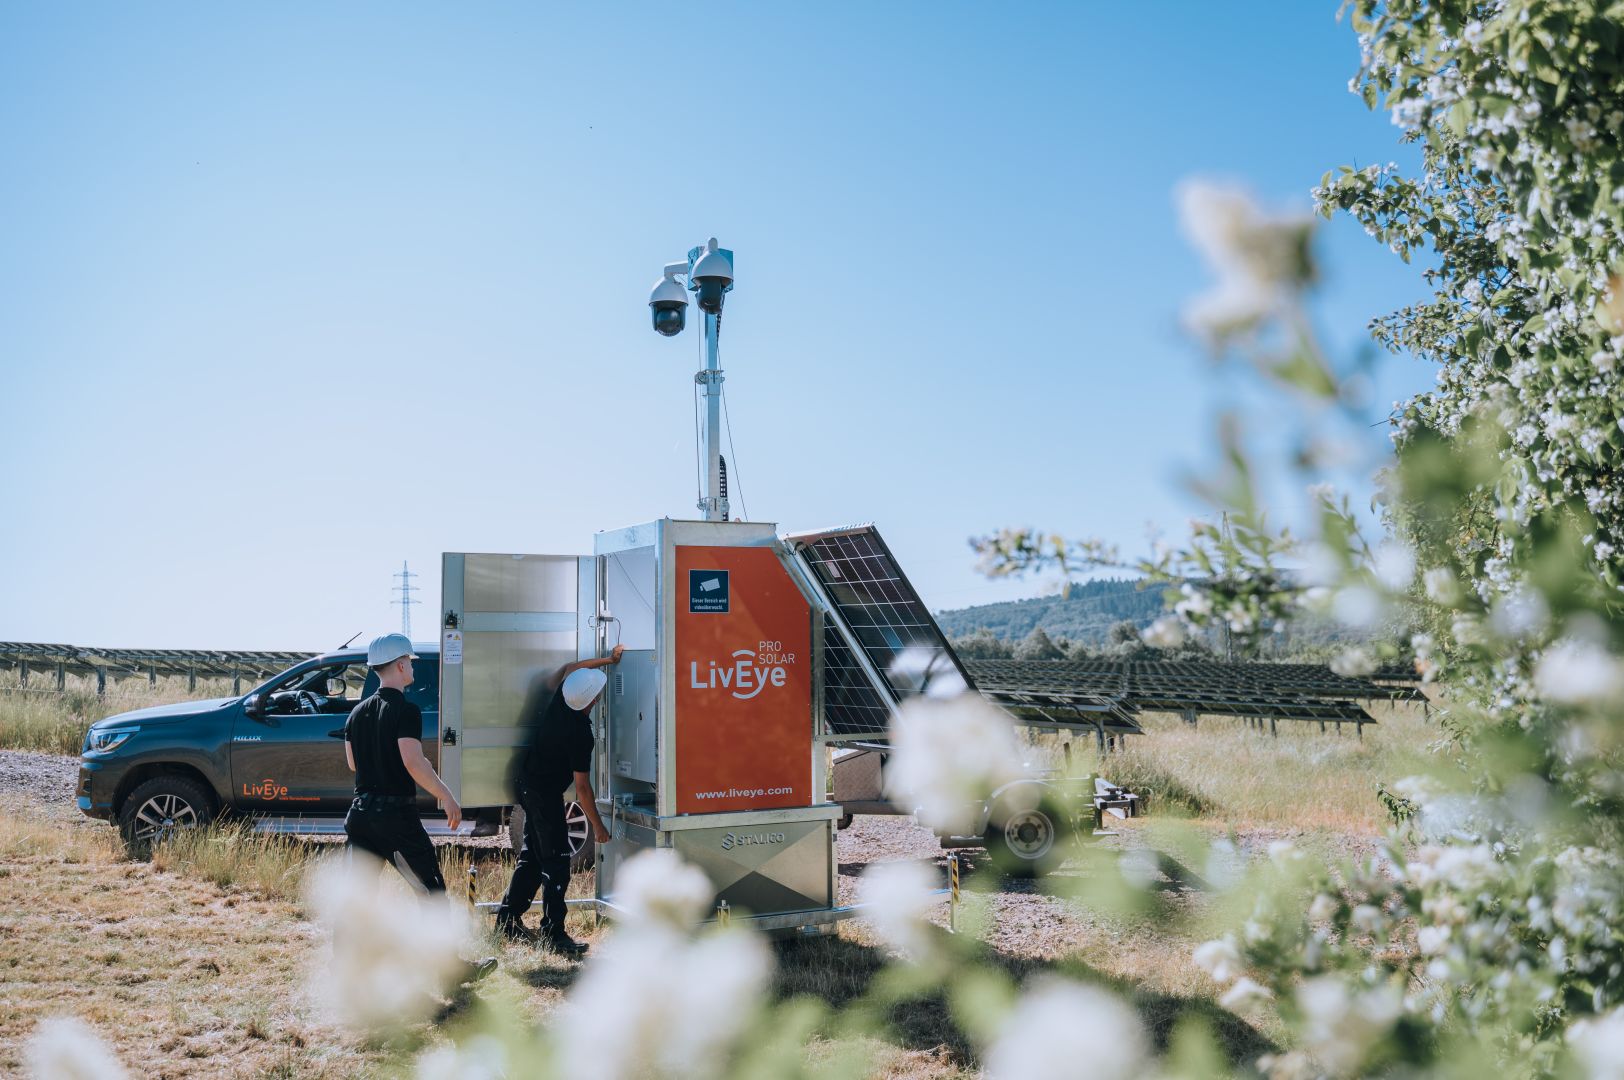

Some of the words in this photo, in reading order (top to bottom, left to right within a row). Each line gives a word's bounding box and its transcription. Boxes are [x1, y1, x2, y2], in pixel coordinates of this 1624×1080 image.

[759, 641, 782, 652] PRO
[759, 653, 795, 664] SOLAR
[691, 659, 786, 699] LivEye
[243, 783, 288, 800] LivEye
[696, 787, 793, 800] www.liveye.com
